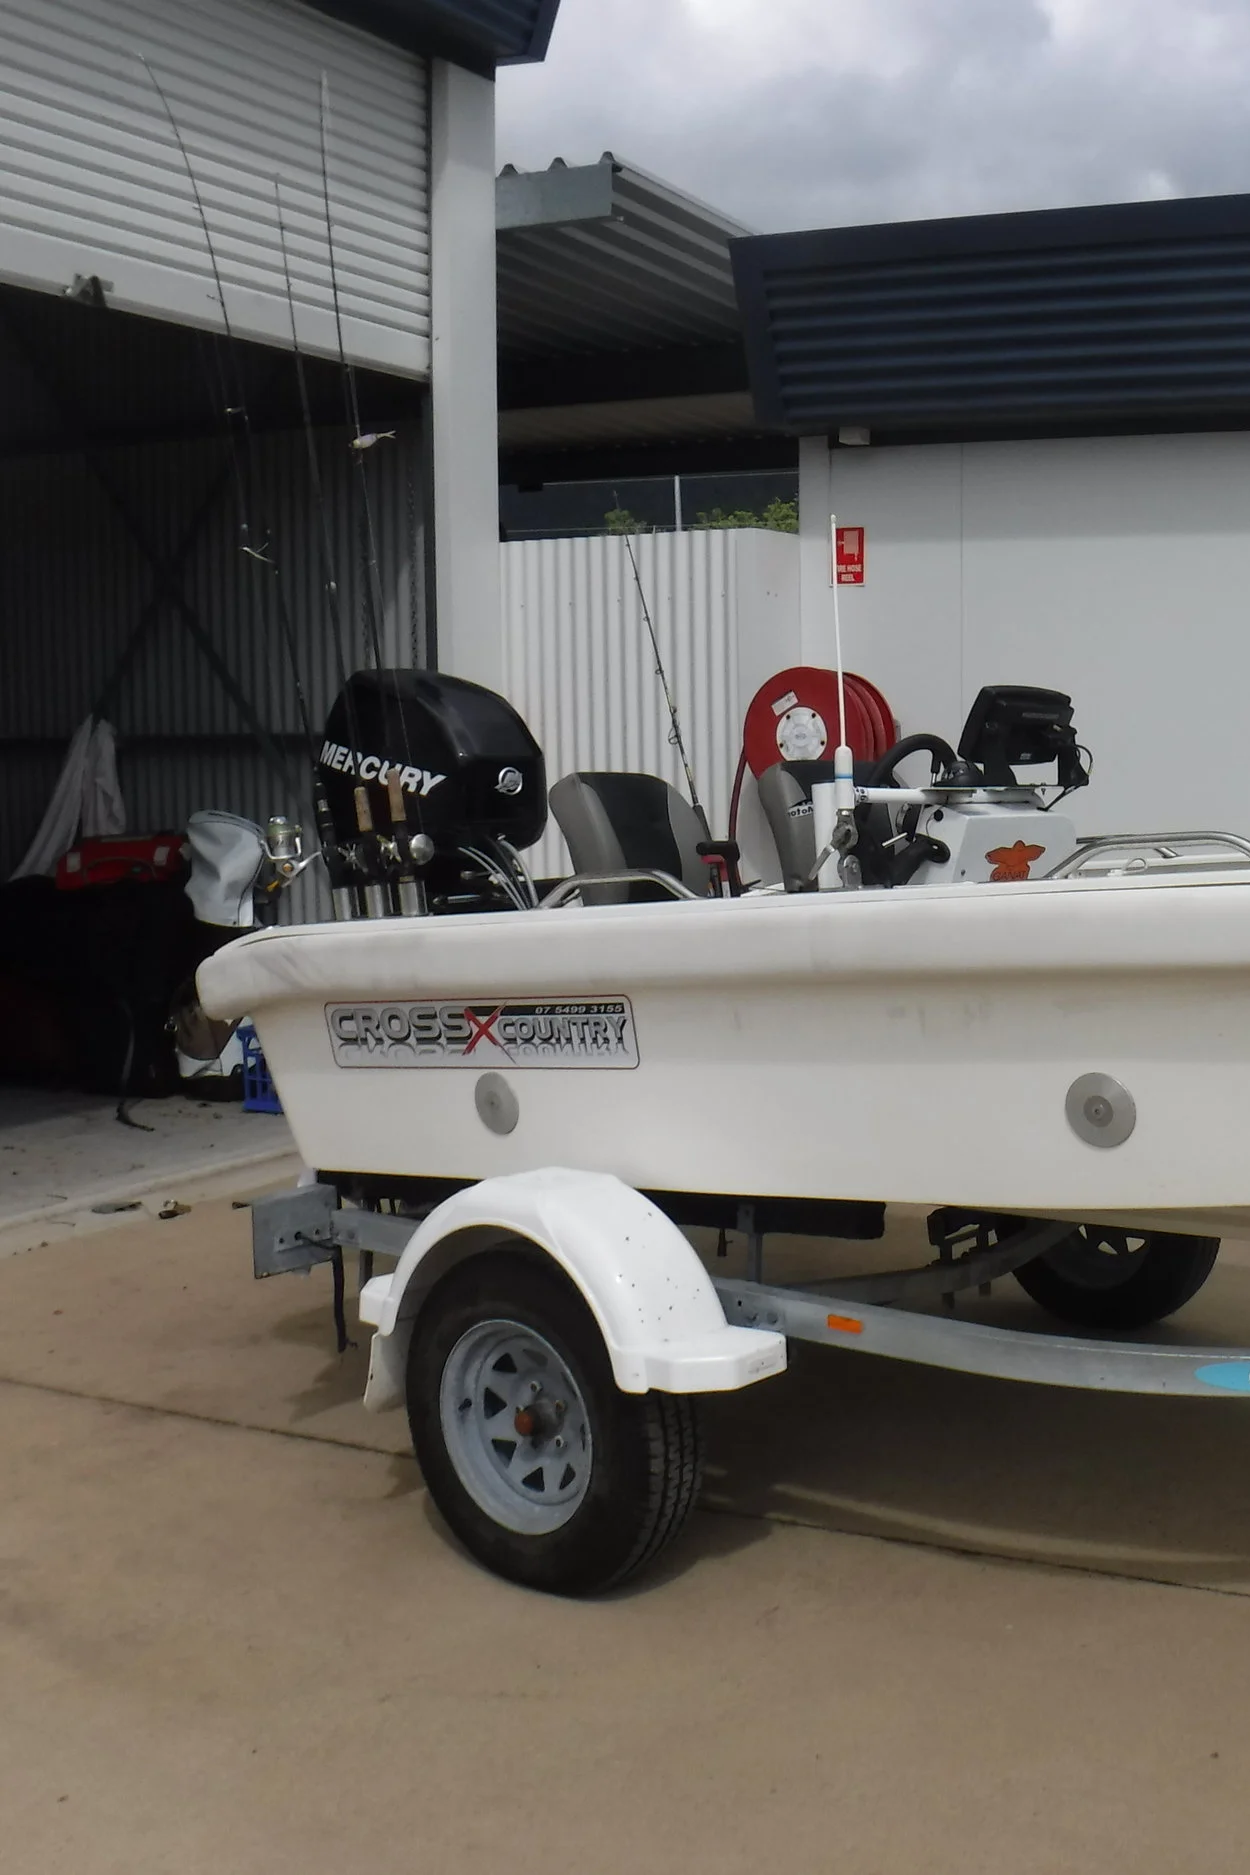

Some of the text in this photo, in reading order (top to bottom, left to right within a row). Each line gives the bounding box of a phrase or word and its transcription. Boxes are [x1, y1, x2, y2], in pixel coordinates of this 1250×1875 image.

[320, 740, 447, 796] MERCURY
[331, 1006, 473, 1043] CROSS
[498, 1016, 627, 1044] COUNTRY
[535, 1004, 622, 1014] 07 5499 3155
